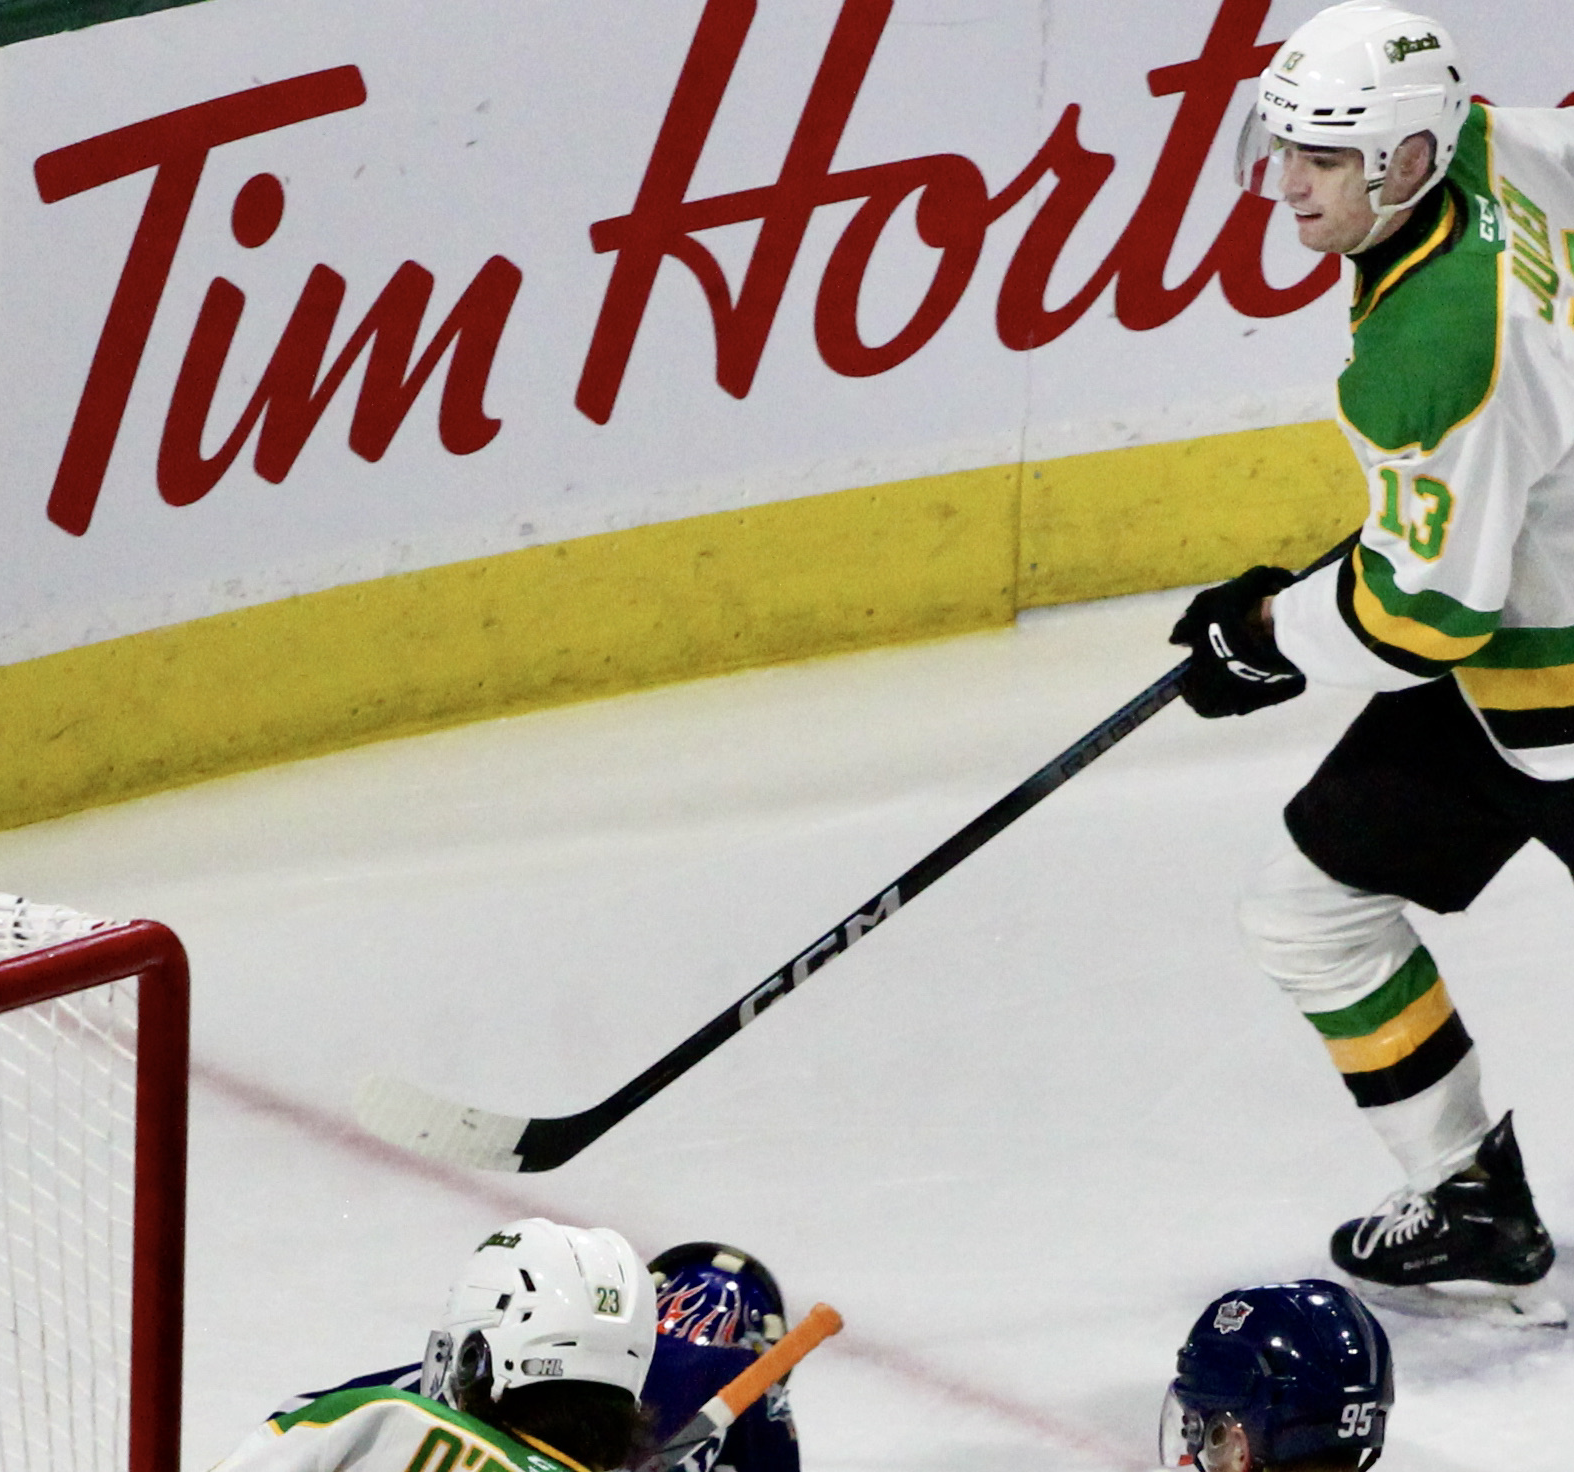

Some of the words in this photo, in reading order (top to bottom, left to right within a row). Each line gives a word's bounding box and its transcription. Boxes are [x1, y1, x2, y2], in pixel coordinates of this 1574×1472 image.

[1263, 90, 1299, 113] CCM
[34, 63, 524, 538] Tim
[1378, 467, 1455, 563] 13
[738, 884, 901, 1030] CCM
[596, 1286, 621, 1314] 23
[1337, 1402, 1377, 1439] 95
